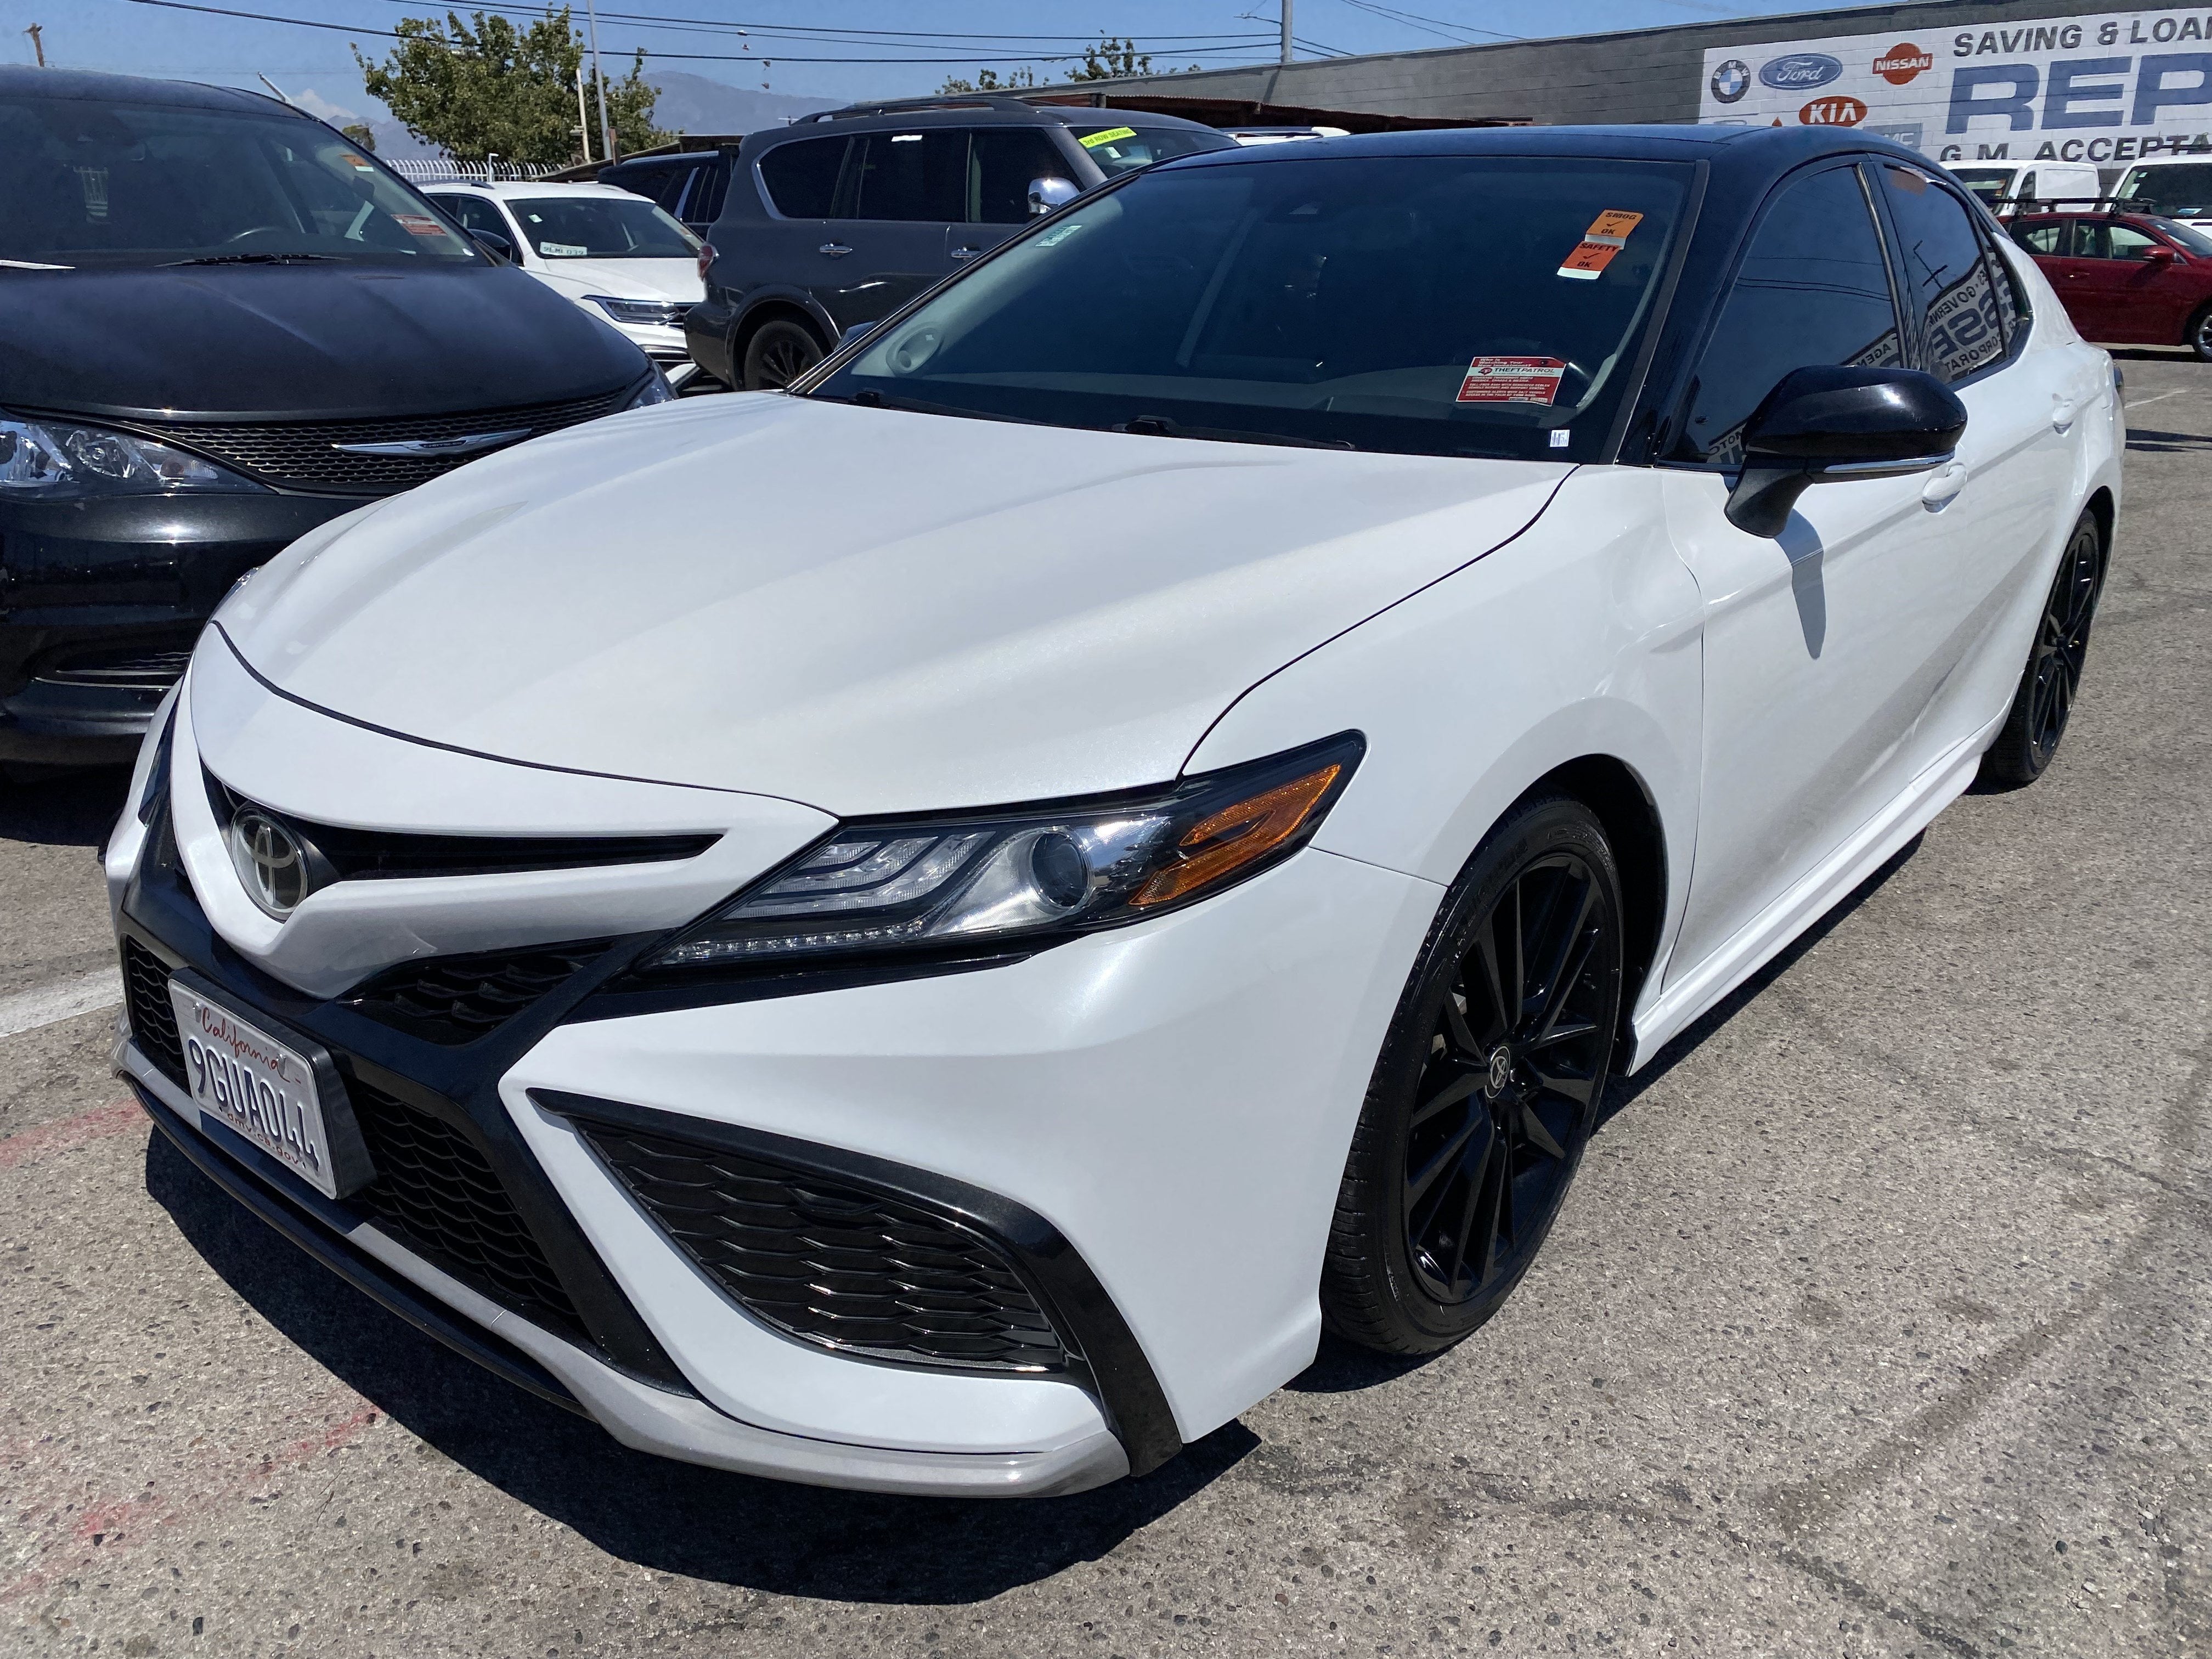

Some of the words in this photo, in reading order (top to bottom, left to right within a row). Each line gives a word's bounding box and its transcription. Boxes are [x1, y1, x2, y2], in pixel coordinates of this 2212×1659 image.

[1954, 24, 2083, 57] SAVING
[2097, 21, 2119, 46] &
[1776, 60, 1824, 82] Ford
[1875, 55, 1930, 72] NISSAN
[1945, 53, 2212, 134] REP
[1809, 102, 1858, 124] KIA
[1094, 134, 1109, 142] ROW
[1606, 212, 1637, 220] SMOG
[1579, 242, 1619, 252] SAFETY
[202, 1007, 291, 1083] California
[188, 1037, 320, 1173] 9GUA044
[227, 1111, 299, 1166] dmv.ca.gov
